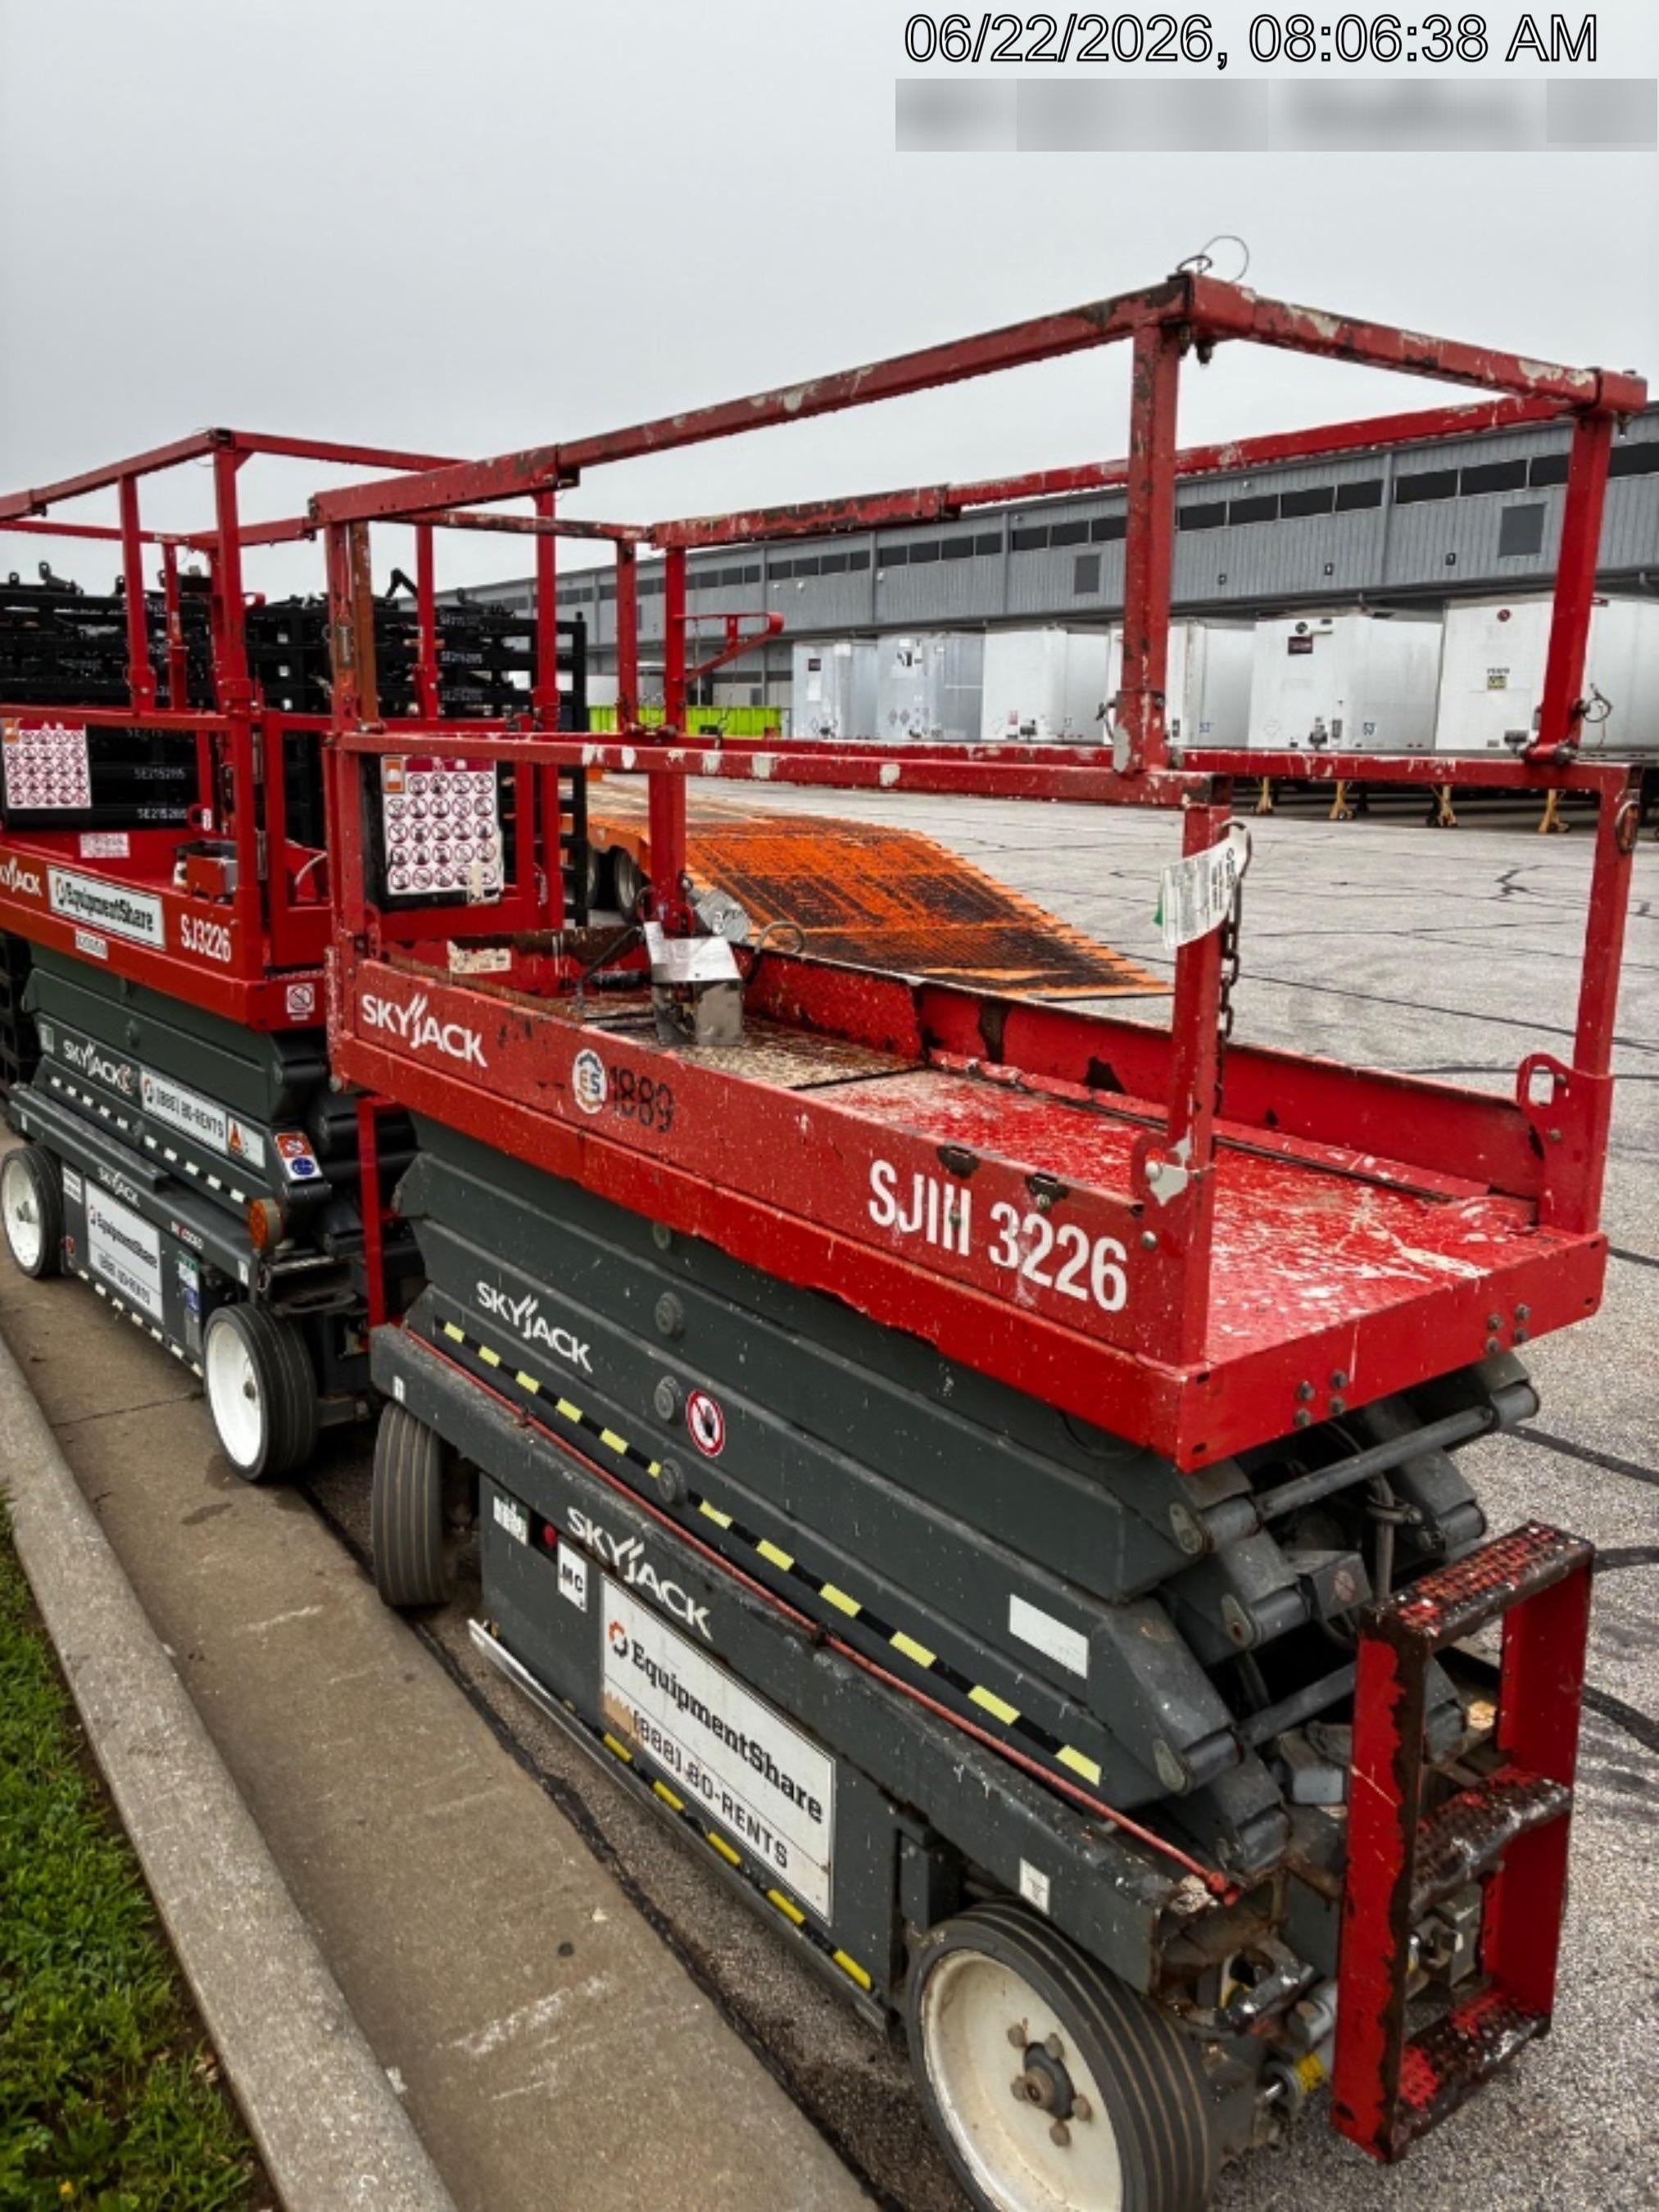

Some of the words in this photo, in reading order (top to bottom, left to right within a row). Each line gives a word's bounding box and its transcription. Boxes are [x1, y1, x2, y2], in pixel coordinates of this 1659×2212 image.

[65, 882, 153, 932] EquipmentShare
[180, 913, 231, 963] SJ3226
[63, 1039, 125, 1091] SKYJACK
[361, 992, 488, 1068] SKYJACK
[988, 1201, 1127, 1312] 3226
[476, 1281, 594, 1374] SKYJACK
[567, 1506, 715, 1643] SKYJACK
[631, 1639, 823, 1825] EquipmentShare
